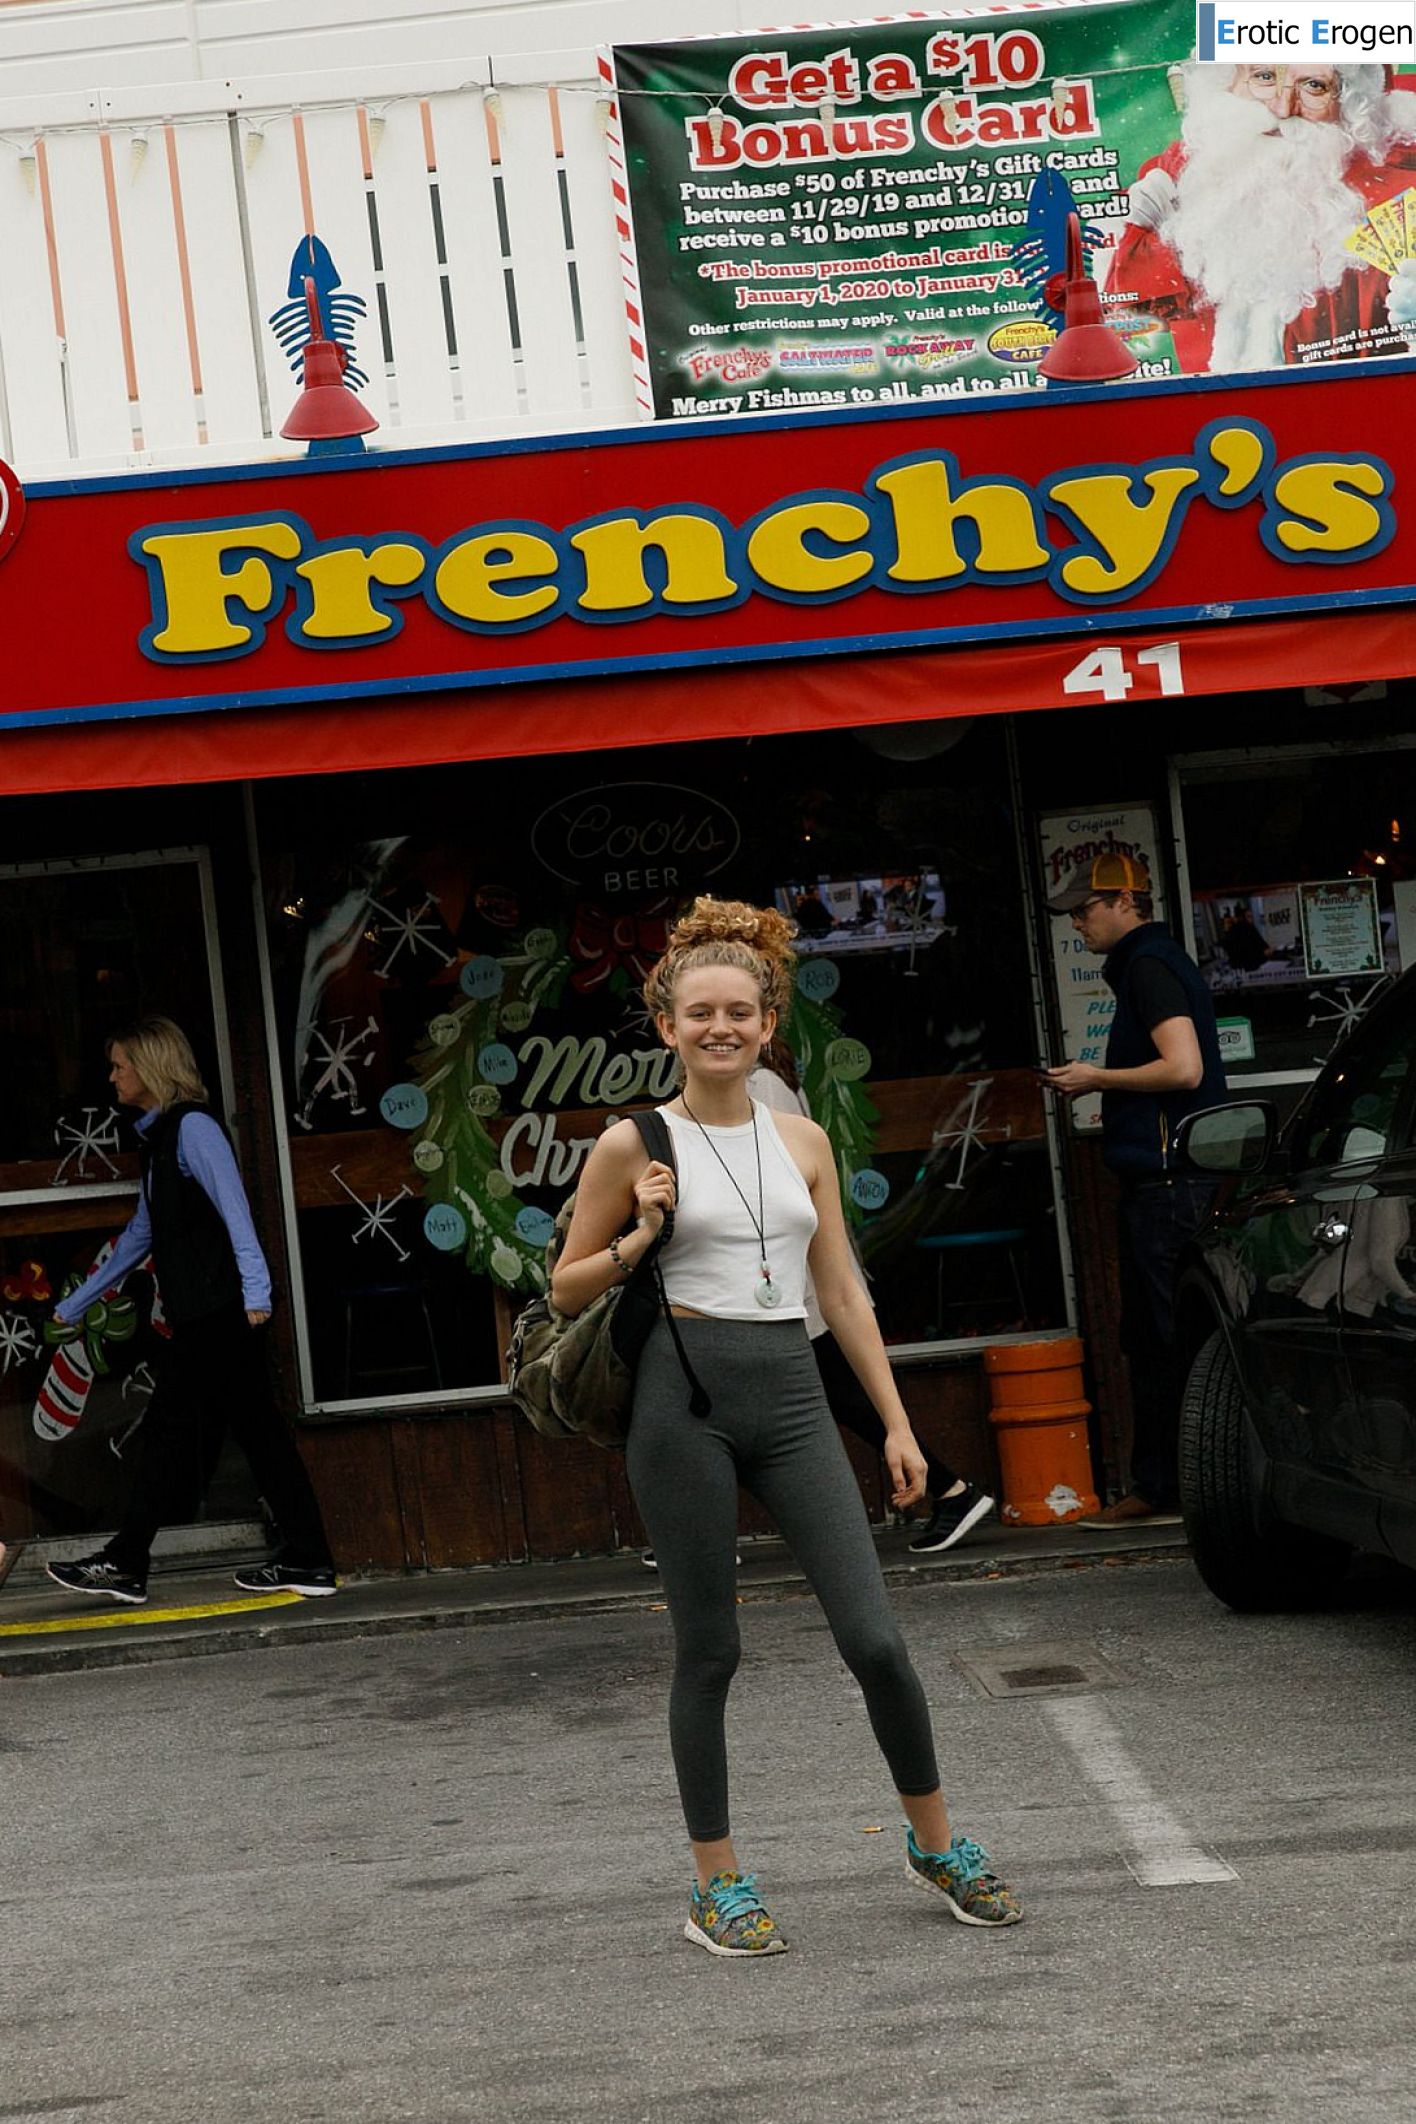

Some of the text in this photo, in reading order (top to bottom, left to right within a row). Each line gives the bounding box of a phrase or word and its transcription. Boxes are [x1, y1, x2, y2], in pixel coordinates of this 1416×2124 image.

[733, 34, 1041, 105] Get a $10
[690, 85, 1096, 167] Bonus Card
[680, 147, 1118, 200] Purchase $50 of Frenchy's Gift Cards
[684, 172, 1120, 225] between 11/29/19 and 12/31/ and
[680, 228, 765, 250] receive
[770, 232, 786, 246] a
[790, 225, 829, 244] $10
[833, 221, 909, 241] bonus
[1077, 196, 1129, 218] ard!
[754, 262, 815, 277] bonus
[818, 248, 941, 278] promotional
[944, 244, 990, 262] card
[737, 287, 816, 306] January
[820, 286, 838, 303] 1,
[841, 281, 889, 299] 2020
[893, 280, 914, 295] to
[918, 275, 998, 297] January
[688, 323, 730, 336] Other
[733, 317, 814, 332] restrictions
[818, 317, 849, 330] may
[852, 312, 898, 328] apply.
[904, 307, 945, 321] Valid
[948, 307, 964, 318] at
[967, 303, 990, 315] the
[1297, 339, 1331, 352] Bonus
[1333, 330, 1356, 344] card
[1358, 328, 1369, 338] is
[1371, 325, 1389, 335] not
[1302, 351, 1322, 362] gift
[1324, 343, 1353, 357] cards
[1355, 340, 1373, 350] are
[672, 396, 743, 416] Merry
[748, 387, 846, 408] Fishmas
[851, 386, 874, 402] to
[921, 376, 966, 397] and
[971, 377, 994, 392] to
[1000, 371, 1029, 389] all
[142, 427, 1385, 653] Frenchy's
[1063, 641, 1184, 700] 41
[560, 803, 726, 858] Coors
[1067, 814, 1125, 833] Original
[603, 866, 680, 893] BEER
[1061, 940, 1069, 953] 7
[1087, 1000, 1116, 1015] PLE
[1080, 1047, 1100, 1060] BE
